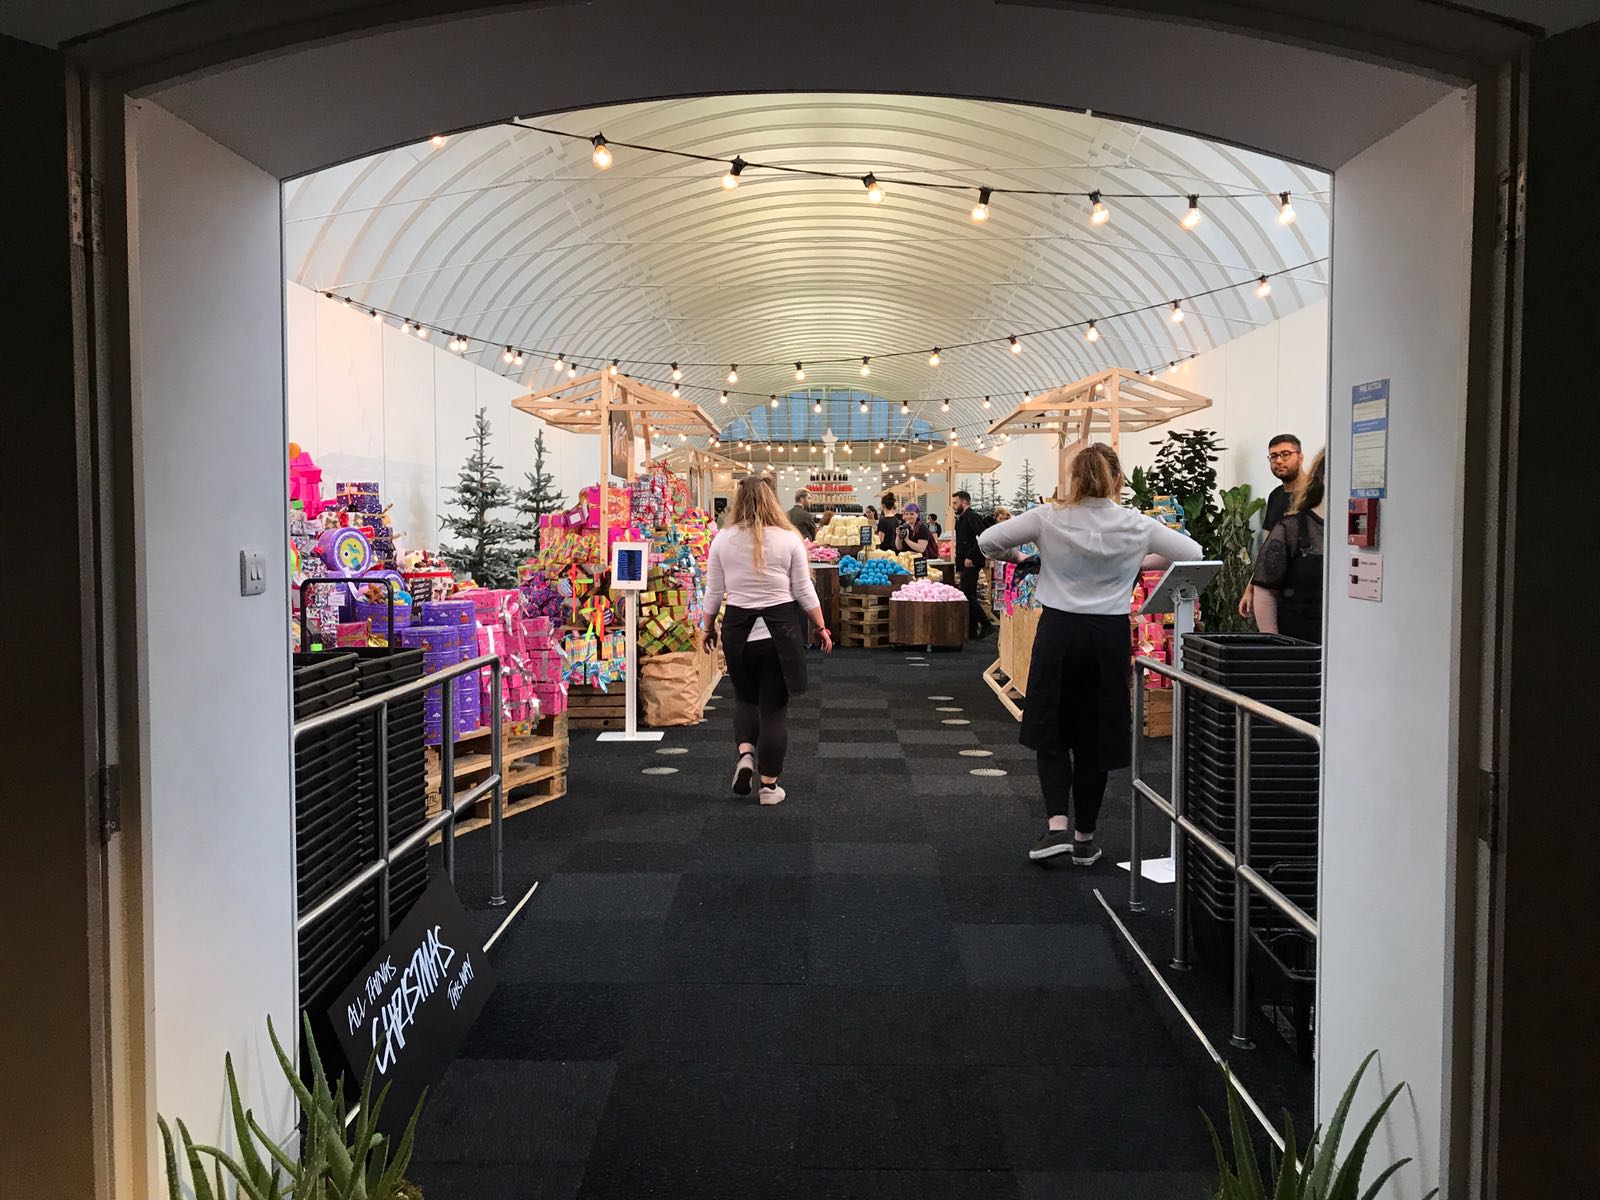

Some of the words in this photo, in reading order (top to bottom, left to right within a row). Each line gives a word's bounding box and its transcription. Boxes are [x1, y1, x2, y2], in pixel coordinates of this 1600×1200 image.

[447, 979, 464, 1011] THIS
[458, 952, 475, 988] WAY
[346, 996, 367, 1036] ALL
